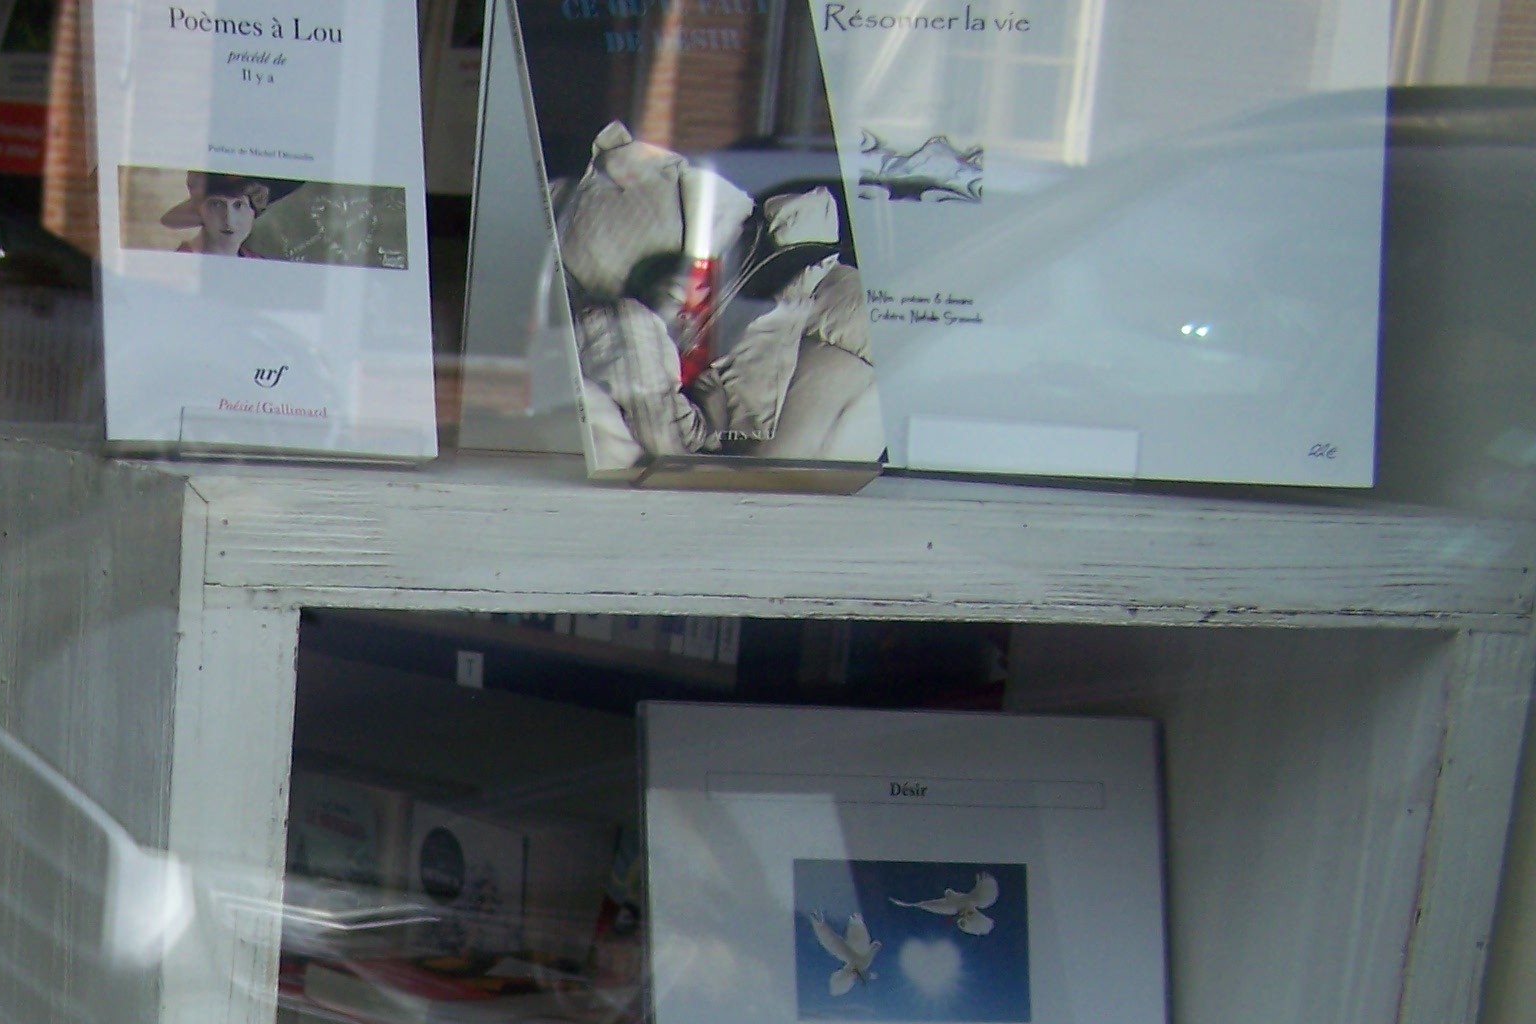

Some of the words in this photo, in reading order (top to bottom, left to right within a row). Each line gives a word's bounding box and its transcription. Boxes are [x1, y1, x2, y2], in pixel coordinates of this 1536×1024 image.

[169, 7, 263, 37] Poèmes
[271, 17, 283, 38] à
[293, 18, 342, 43] Lou
[823, 3, 959, 33] Résonner
[965, 5, 986, 32] la
[994, 13, 1030, 33] vie
[227, 51, 270, 64] précédé
[273, 53, 287, 65] de
[256, 73, 264, 84] y
[267, 74, 274, 83] a
[254, 364, 289, 388] nrf
[890, 782, 927, 797] Désir
